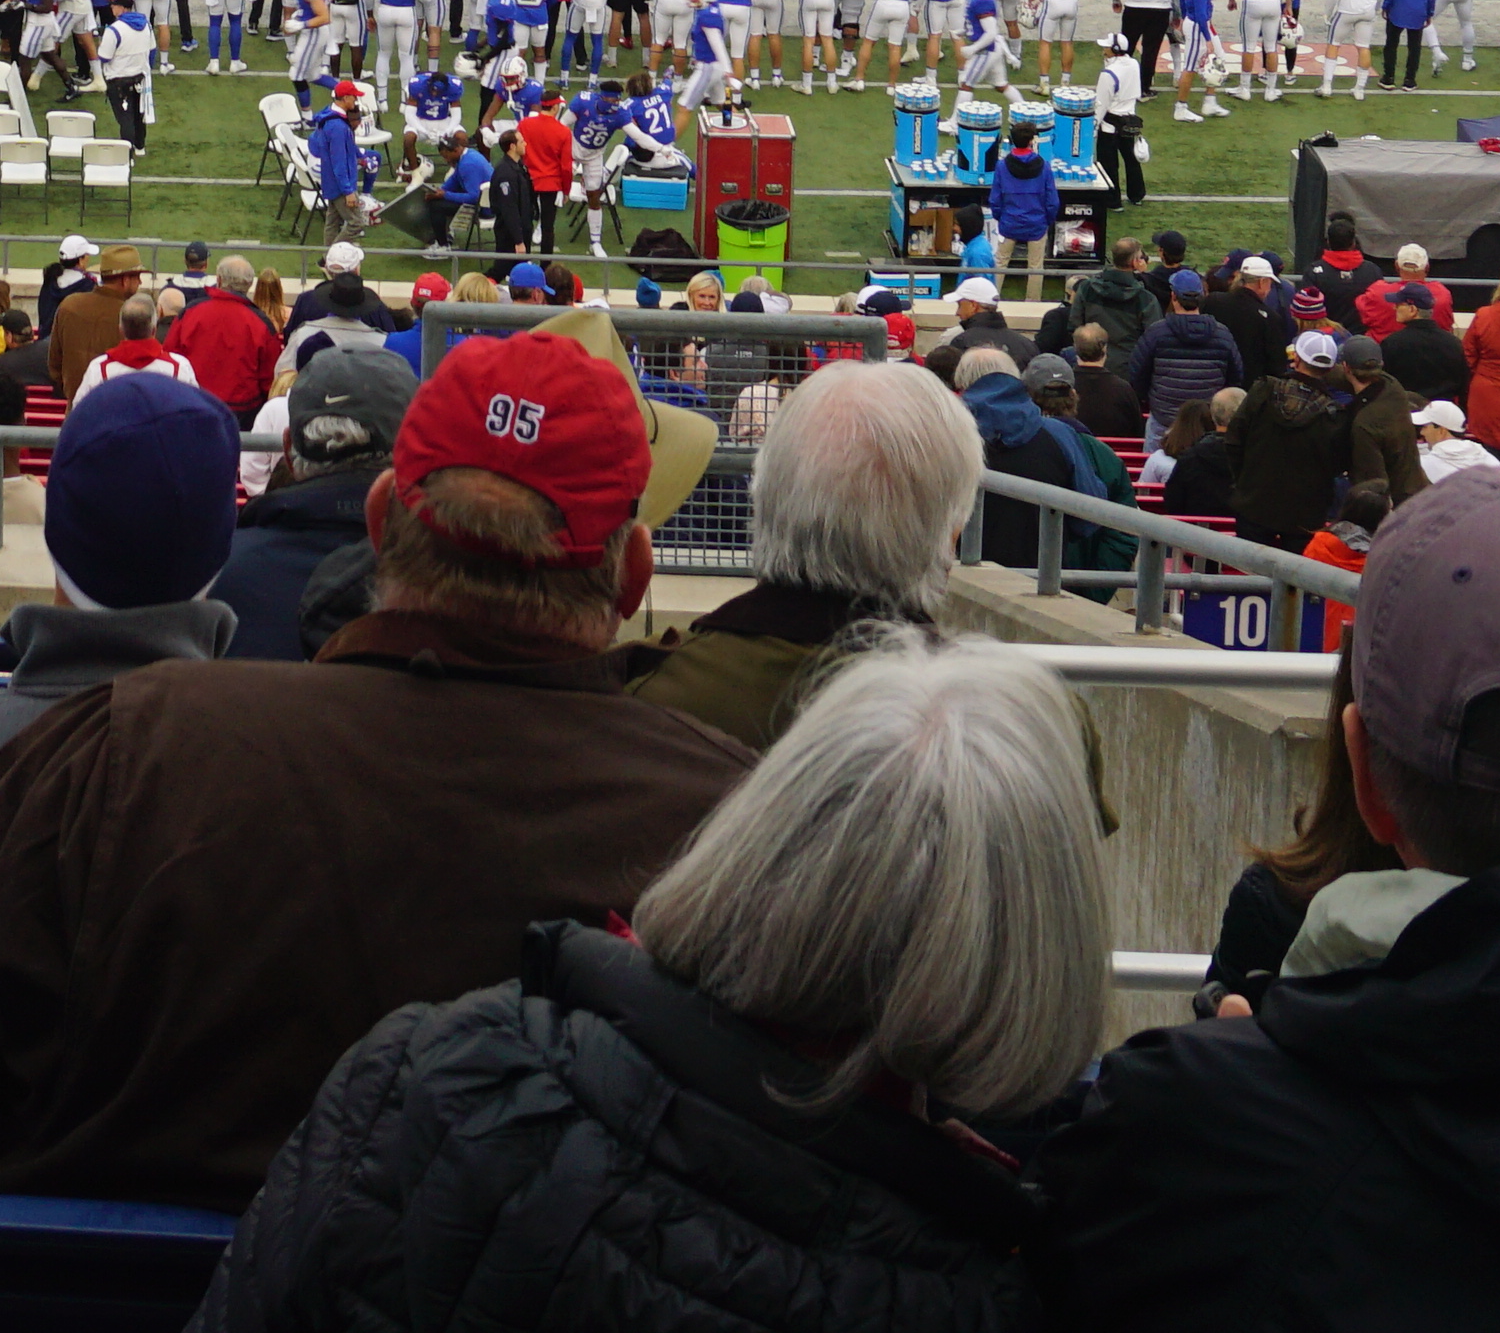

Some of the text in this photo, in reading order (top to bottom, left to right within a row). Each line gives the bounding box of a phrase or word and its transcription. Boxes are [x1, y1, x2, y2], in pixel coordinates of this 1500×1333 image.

[646, 107, 671, 134] 21
[580, 129, 609, 148] 26
[1064, 207, 1093, 216] RHINO
[485, 393, 546, 445] 95
[1218, 594, 1268, 648] 10
